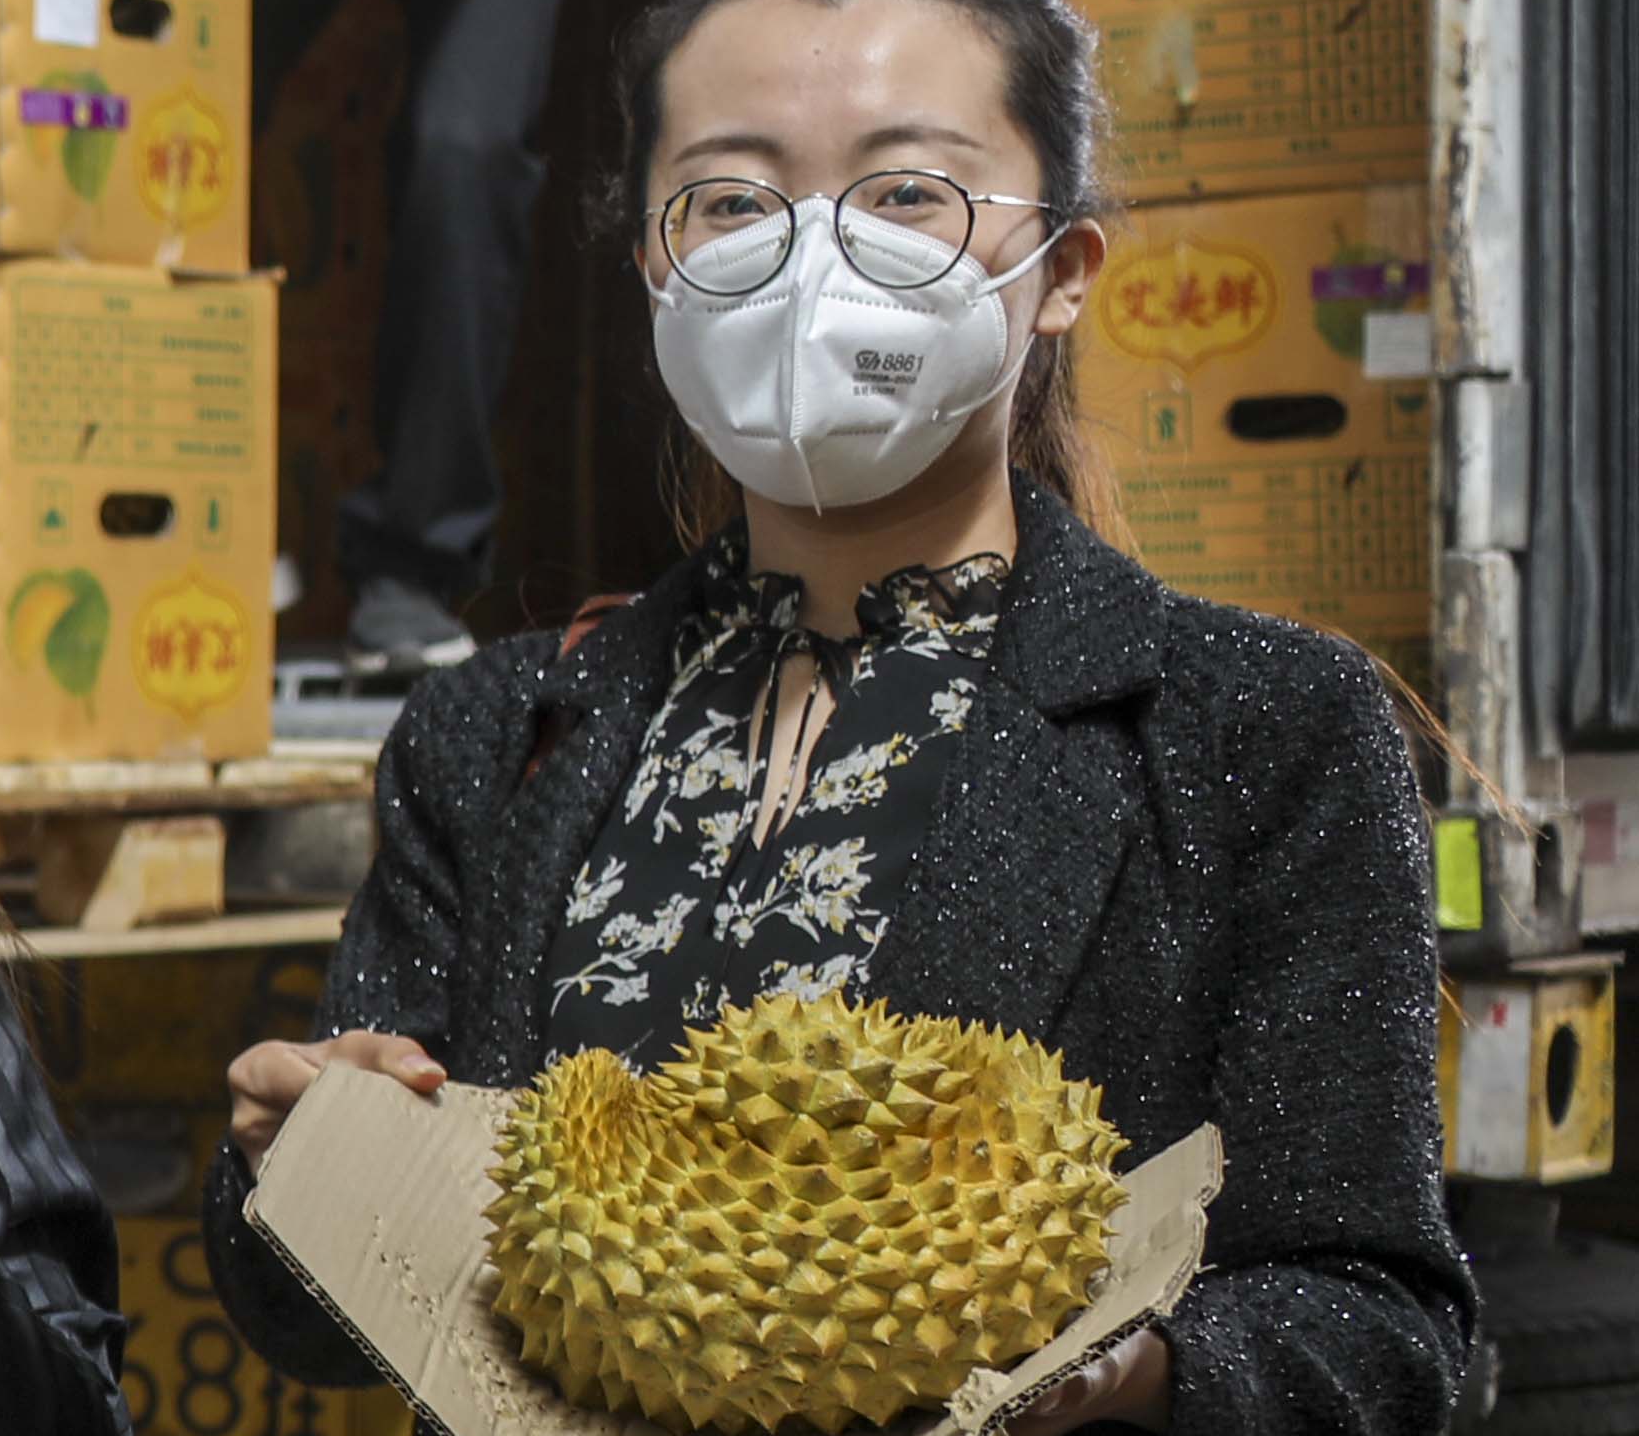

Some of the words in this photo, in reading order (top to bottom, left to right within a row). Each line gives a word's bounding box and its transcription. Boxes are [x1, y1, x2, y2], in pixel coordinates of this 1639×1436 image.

[1119, 271, 1261, 330] 艾美鲜
[882, 352, 924, 373] 8861
